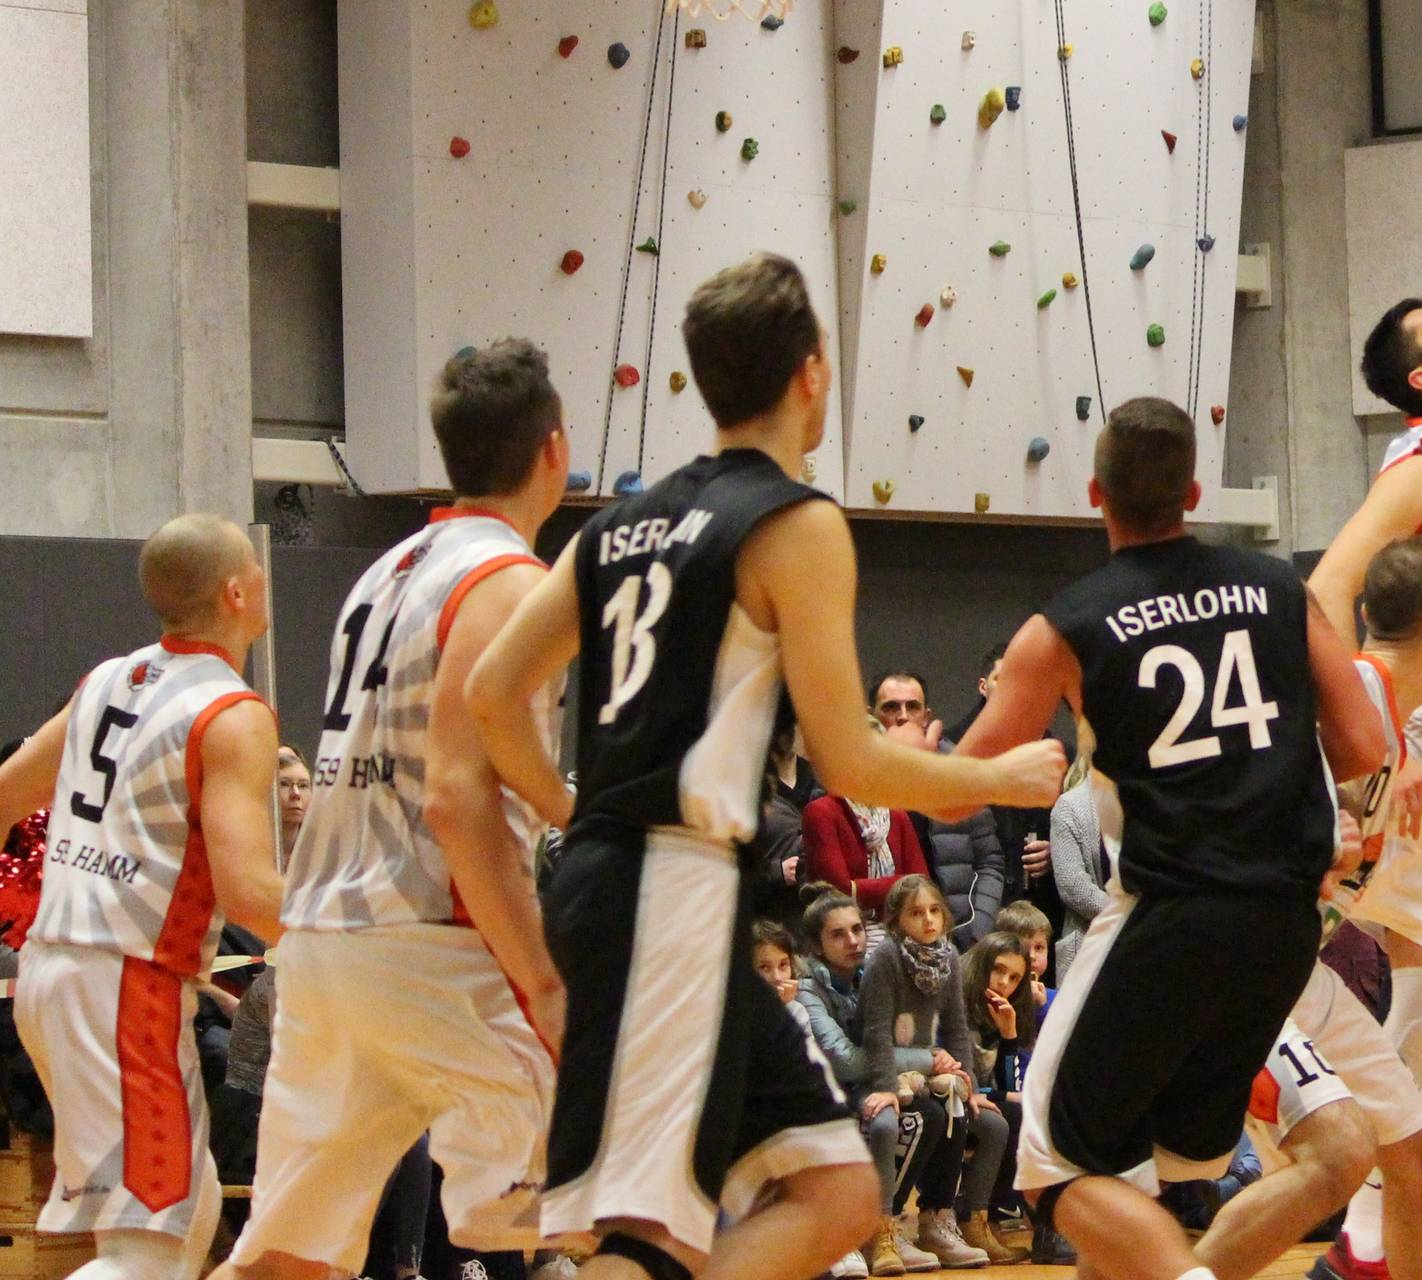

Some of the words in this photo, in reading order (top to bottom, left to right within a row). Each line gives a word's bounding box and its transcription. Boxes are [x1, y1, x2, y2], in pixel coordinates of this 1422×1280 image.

[1105, 585, 1268, 643] ISERLOHN
[1137, 629, 1280, 769] 24
[70, 705, 140, 824] 5
[71, 845, 142, 884] HAMM
